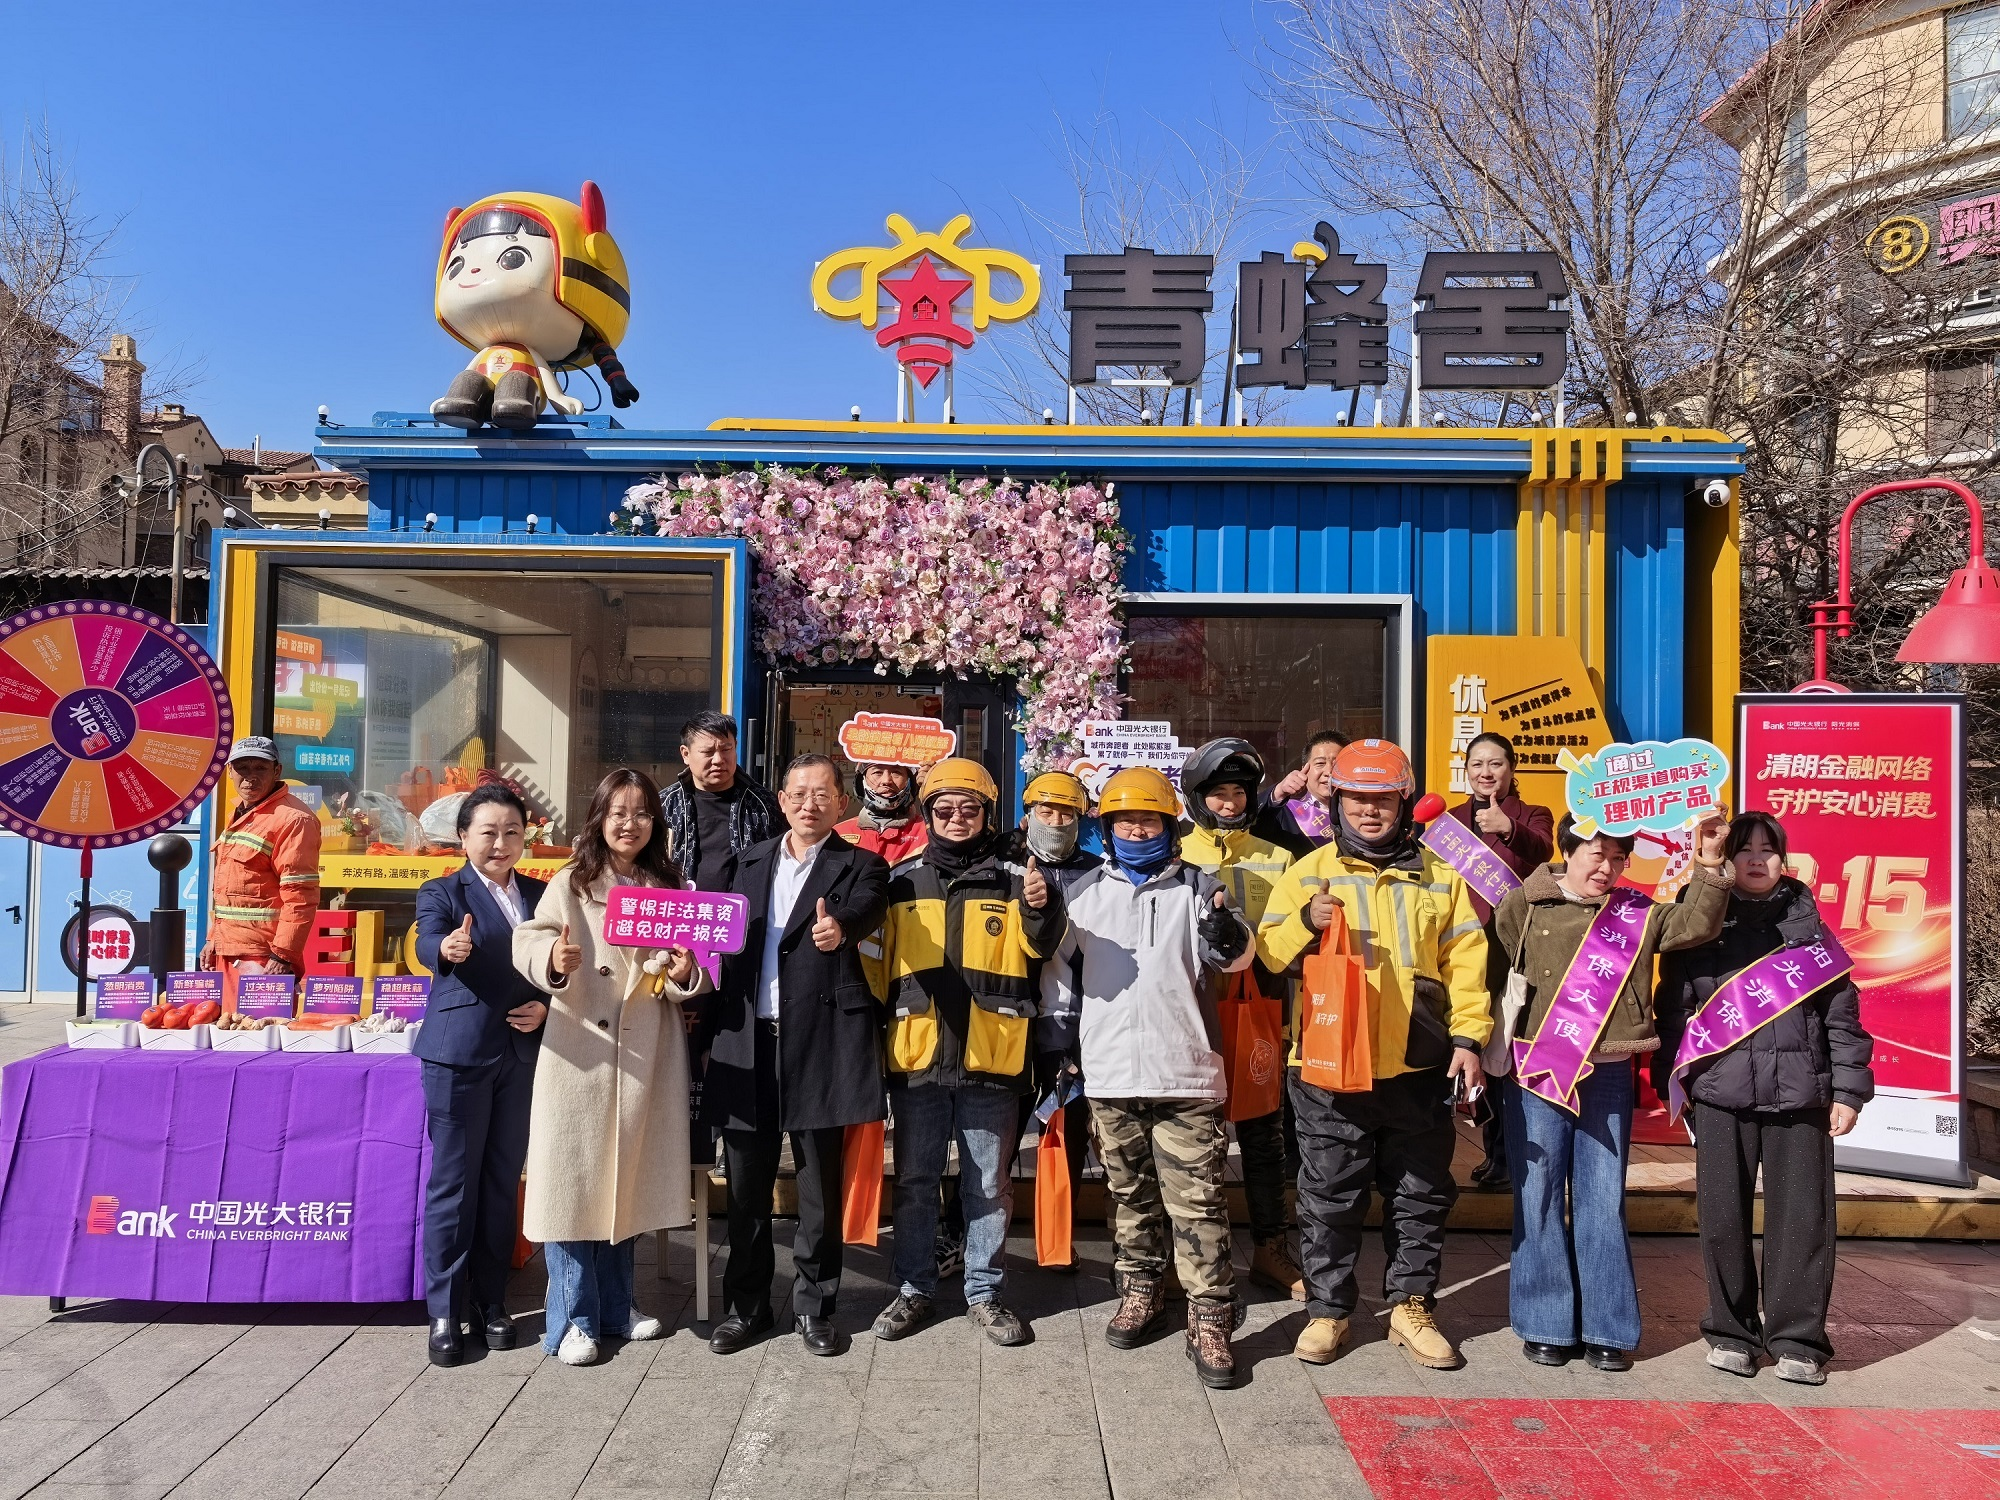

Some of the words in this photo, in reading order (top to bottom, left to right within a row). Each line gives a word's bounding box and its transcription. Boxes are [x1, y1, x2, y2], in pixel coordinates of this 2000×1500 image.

[1064, 221, 1570, 391] 青蜂舍
[88, 694, 122, 745] 中国光大银行
[1085, 724, 1113, 737] Bank
[1116, 724, 1167, 733] 中国光大银行
[1520, 707, 1596, 732] 为奋斗的你点赞
[1763, 720, 1784, 730] Bank
[1091, 742, 1129, 750] 城市奔跑者
[1097, 750, 1143, 759] 累了就停一下
[1605, 749, 1655, 777] 通过
[1757, 753, 1933, 782] 清朗金融网络
[1593, 762, 1710, 799] 正规渠道购买
[1603, 785, 1713, 825] 理财产品
[1766, 787, 1938, 820] 守护安心消费
[620, 897, 734, 922] 警惕非法集资
[616, 919, 729, 944] 避免财产损失
[245, 982, 286, 992] 过关斩姜
[381, 983, 423, 993] 稳超胜蒜
[86, 1195, 179, 1239] Bank
[188, 1200, 353, 1228] 中国光大银行
[186, 1229, 227, 1241] CHINA
[230, 1229, 312, 1242] EVERBRIGHT
[314, 1229, 349, 1242] BANK
